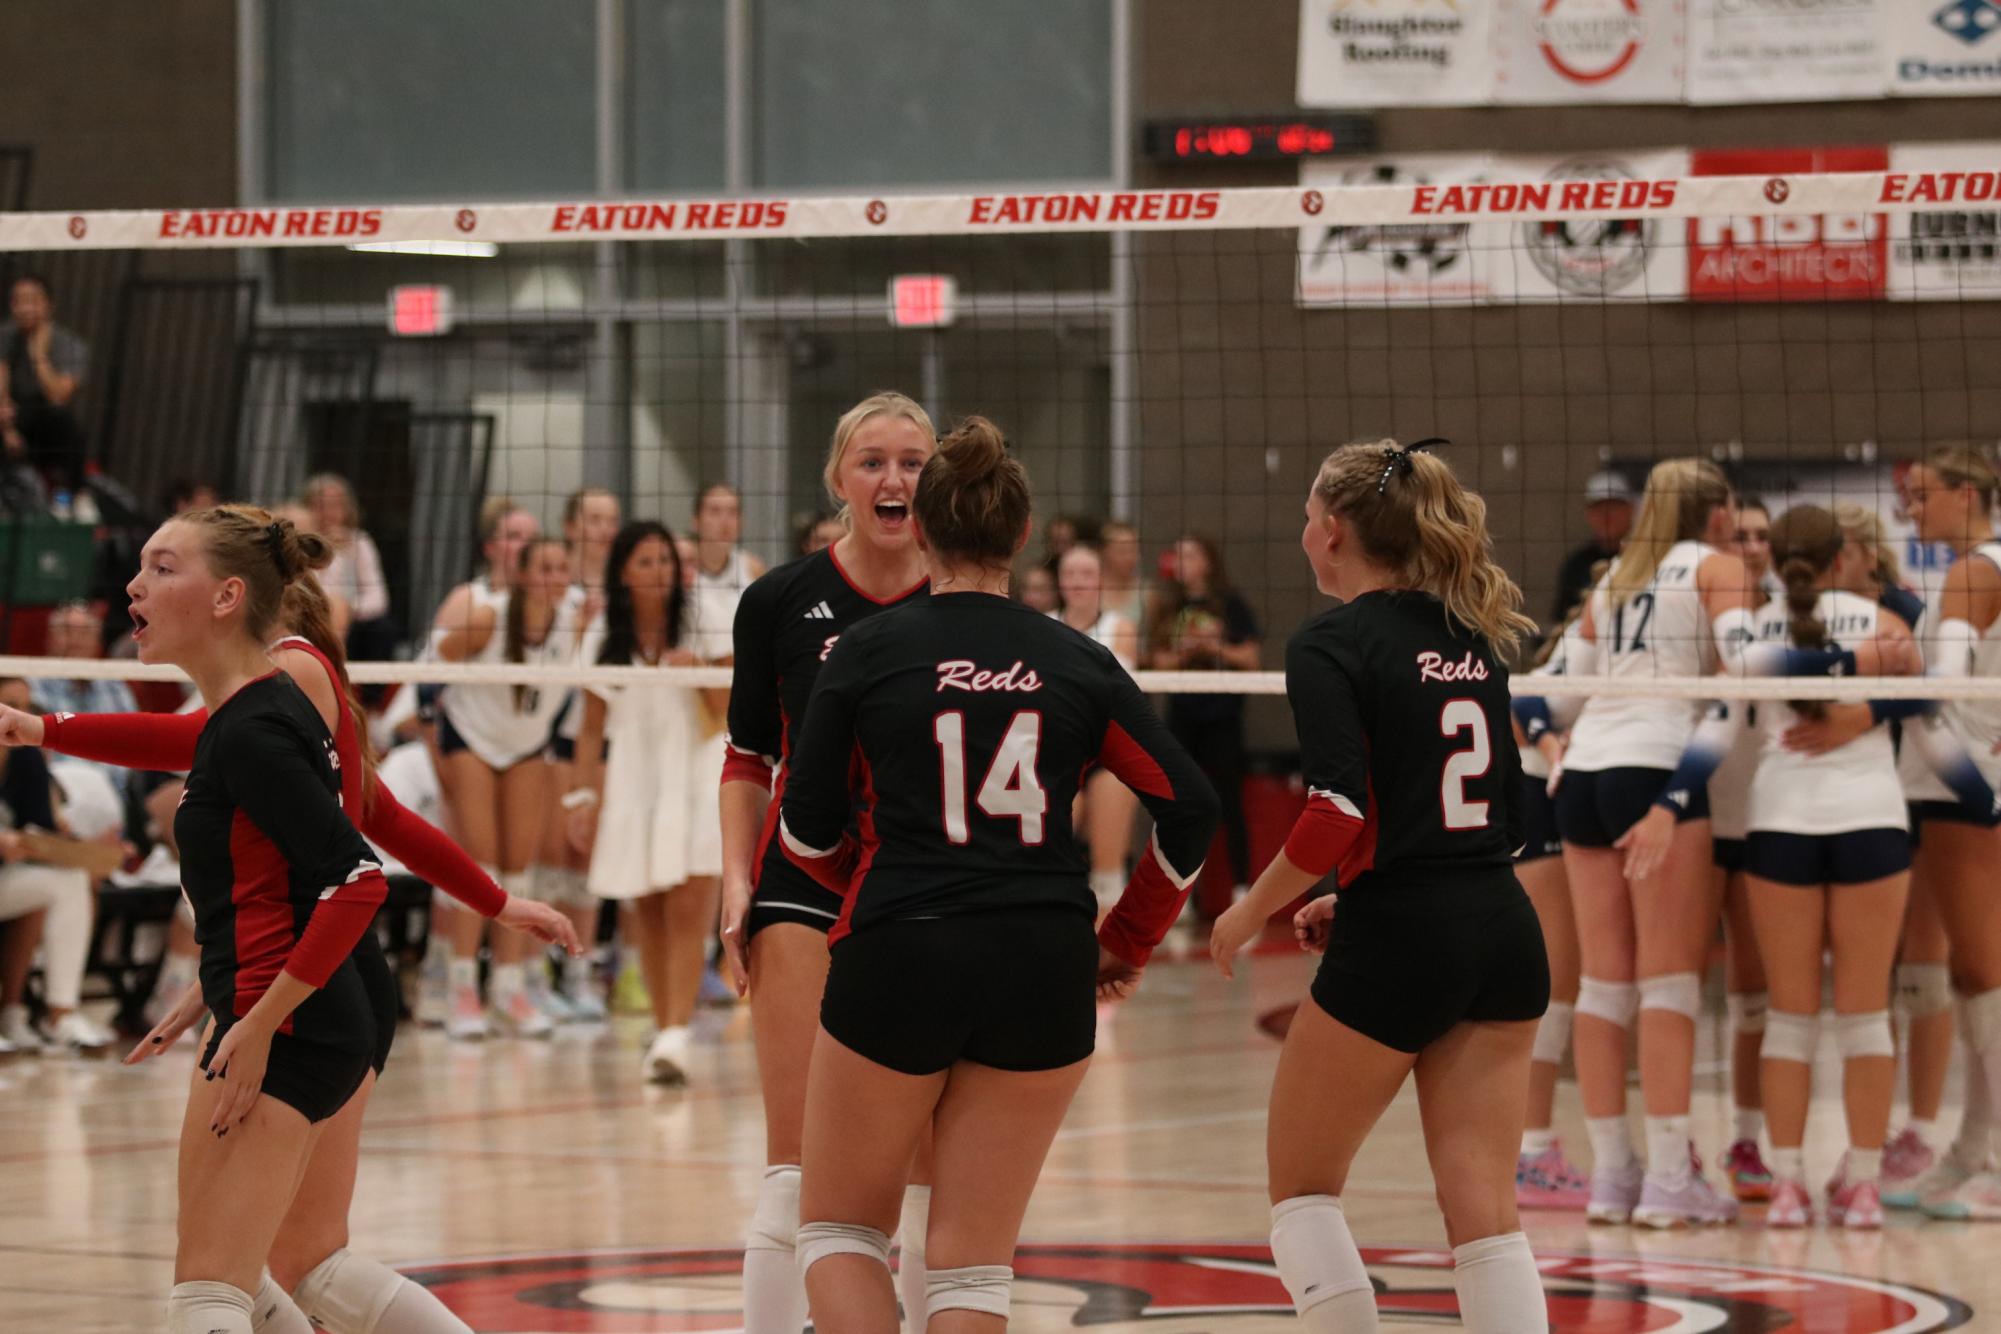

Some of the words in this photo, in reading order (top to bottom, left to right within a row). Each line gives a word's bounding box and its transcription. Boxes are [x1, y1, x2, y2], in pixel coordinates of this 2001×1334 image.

[1410, 183, 1553, 214] EATON
[1559, 180, 1678, 212] REDS
[1879, 173, 2001, 203] EATO
[159, 210, 278, 239] EATON
[282, 209, 384, 238] REDS
[551, 203, 678, 233] EATON
[683, 201, 788, 230] REDS
[968, 194, 1101, 225] EATON
[1106, 192, 1221, 222] REDS
[1615, 593, 1653, 653] 12
[935, 660, 1043, 693] Reds
[1415, 650, 1490, 683] Reds
[934, 710, 1047, 846] 14
[1440, 699, 1492, 830] 2
